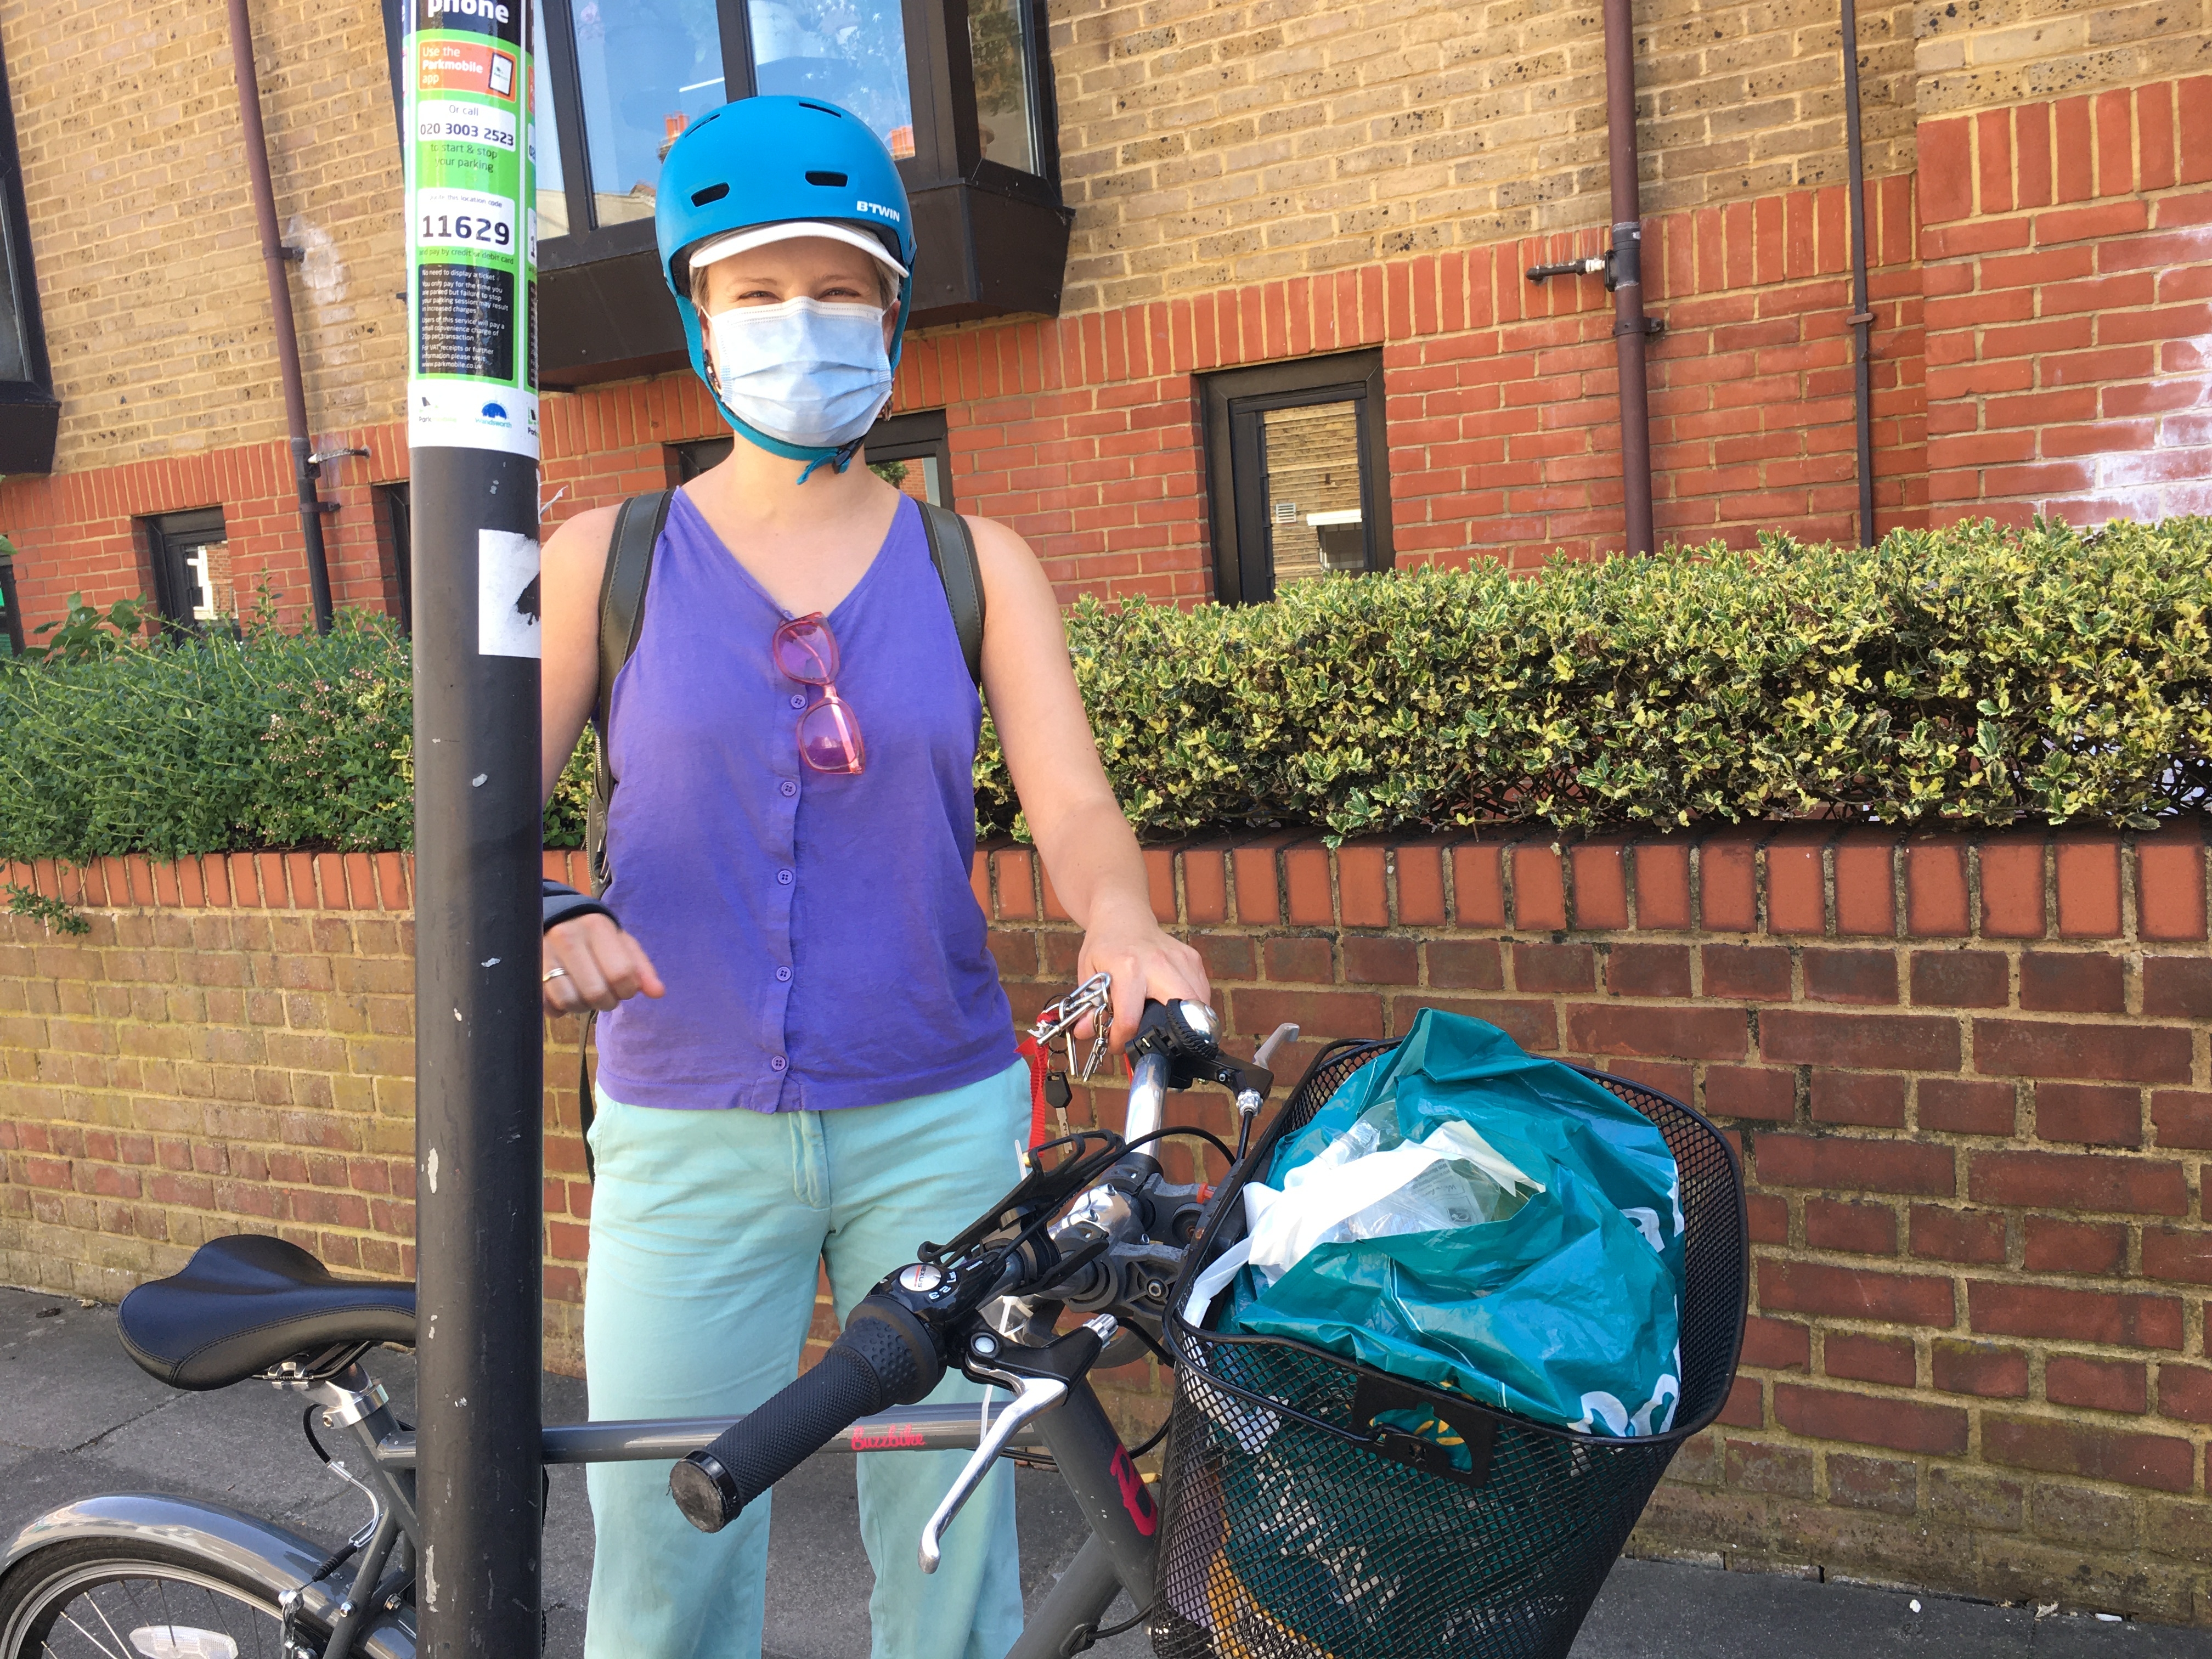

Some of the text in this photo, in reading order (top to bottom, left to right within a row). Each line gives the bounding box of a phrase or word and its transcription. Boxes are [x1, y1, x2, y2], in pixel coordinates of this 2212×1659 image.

[422, 46, 460, 57] Use the
[422, 59, 483, 74] Parkmobile
[422, 75, 439, 85] app
[449, 105, 479, 116] Or call
[420, 123, 514, 146] 020 3003 2523
[431, 144, 497, 160] to start & stop
[435, 158, 494, 173] your parking
[461, 195, 487, 204] location
[488, 199, 503, 208] code
[423, 215, 510, 245] 11629
[451, 249, 472, 257] credit
[482, 252, 500, 261] debit
[500, 256, 514, 264] card
[450, 269, 472, 278] display
[478, 272, 495, 281] ticket
[460, 290, 480, 298] failure
[489, 294, 502, 302] stop
[453, 306, 476, 314] charges
[492, 303, 509, 312] result
[471, 326, 492, 336] charge
[472, 347, 494, 355] further
[475, 417, 512, 428] Wandsworth
[851, 1424, 928, 1451] Buzzbike
